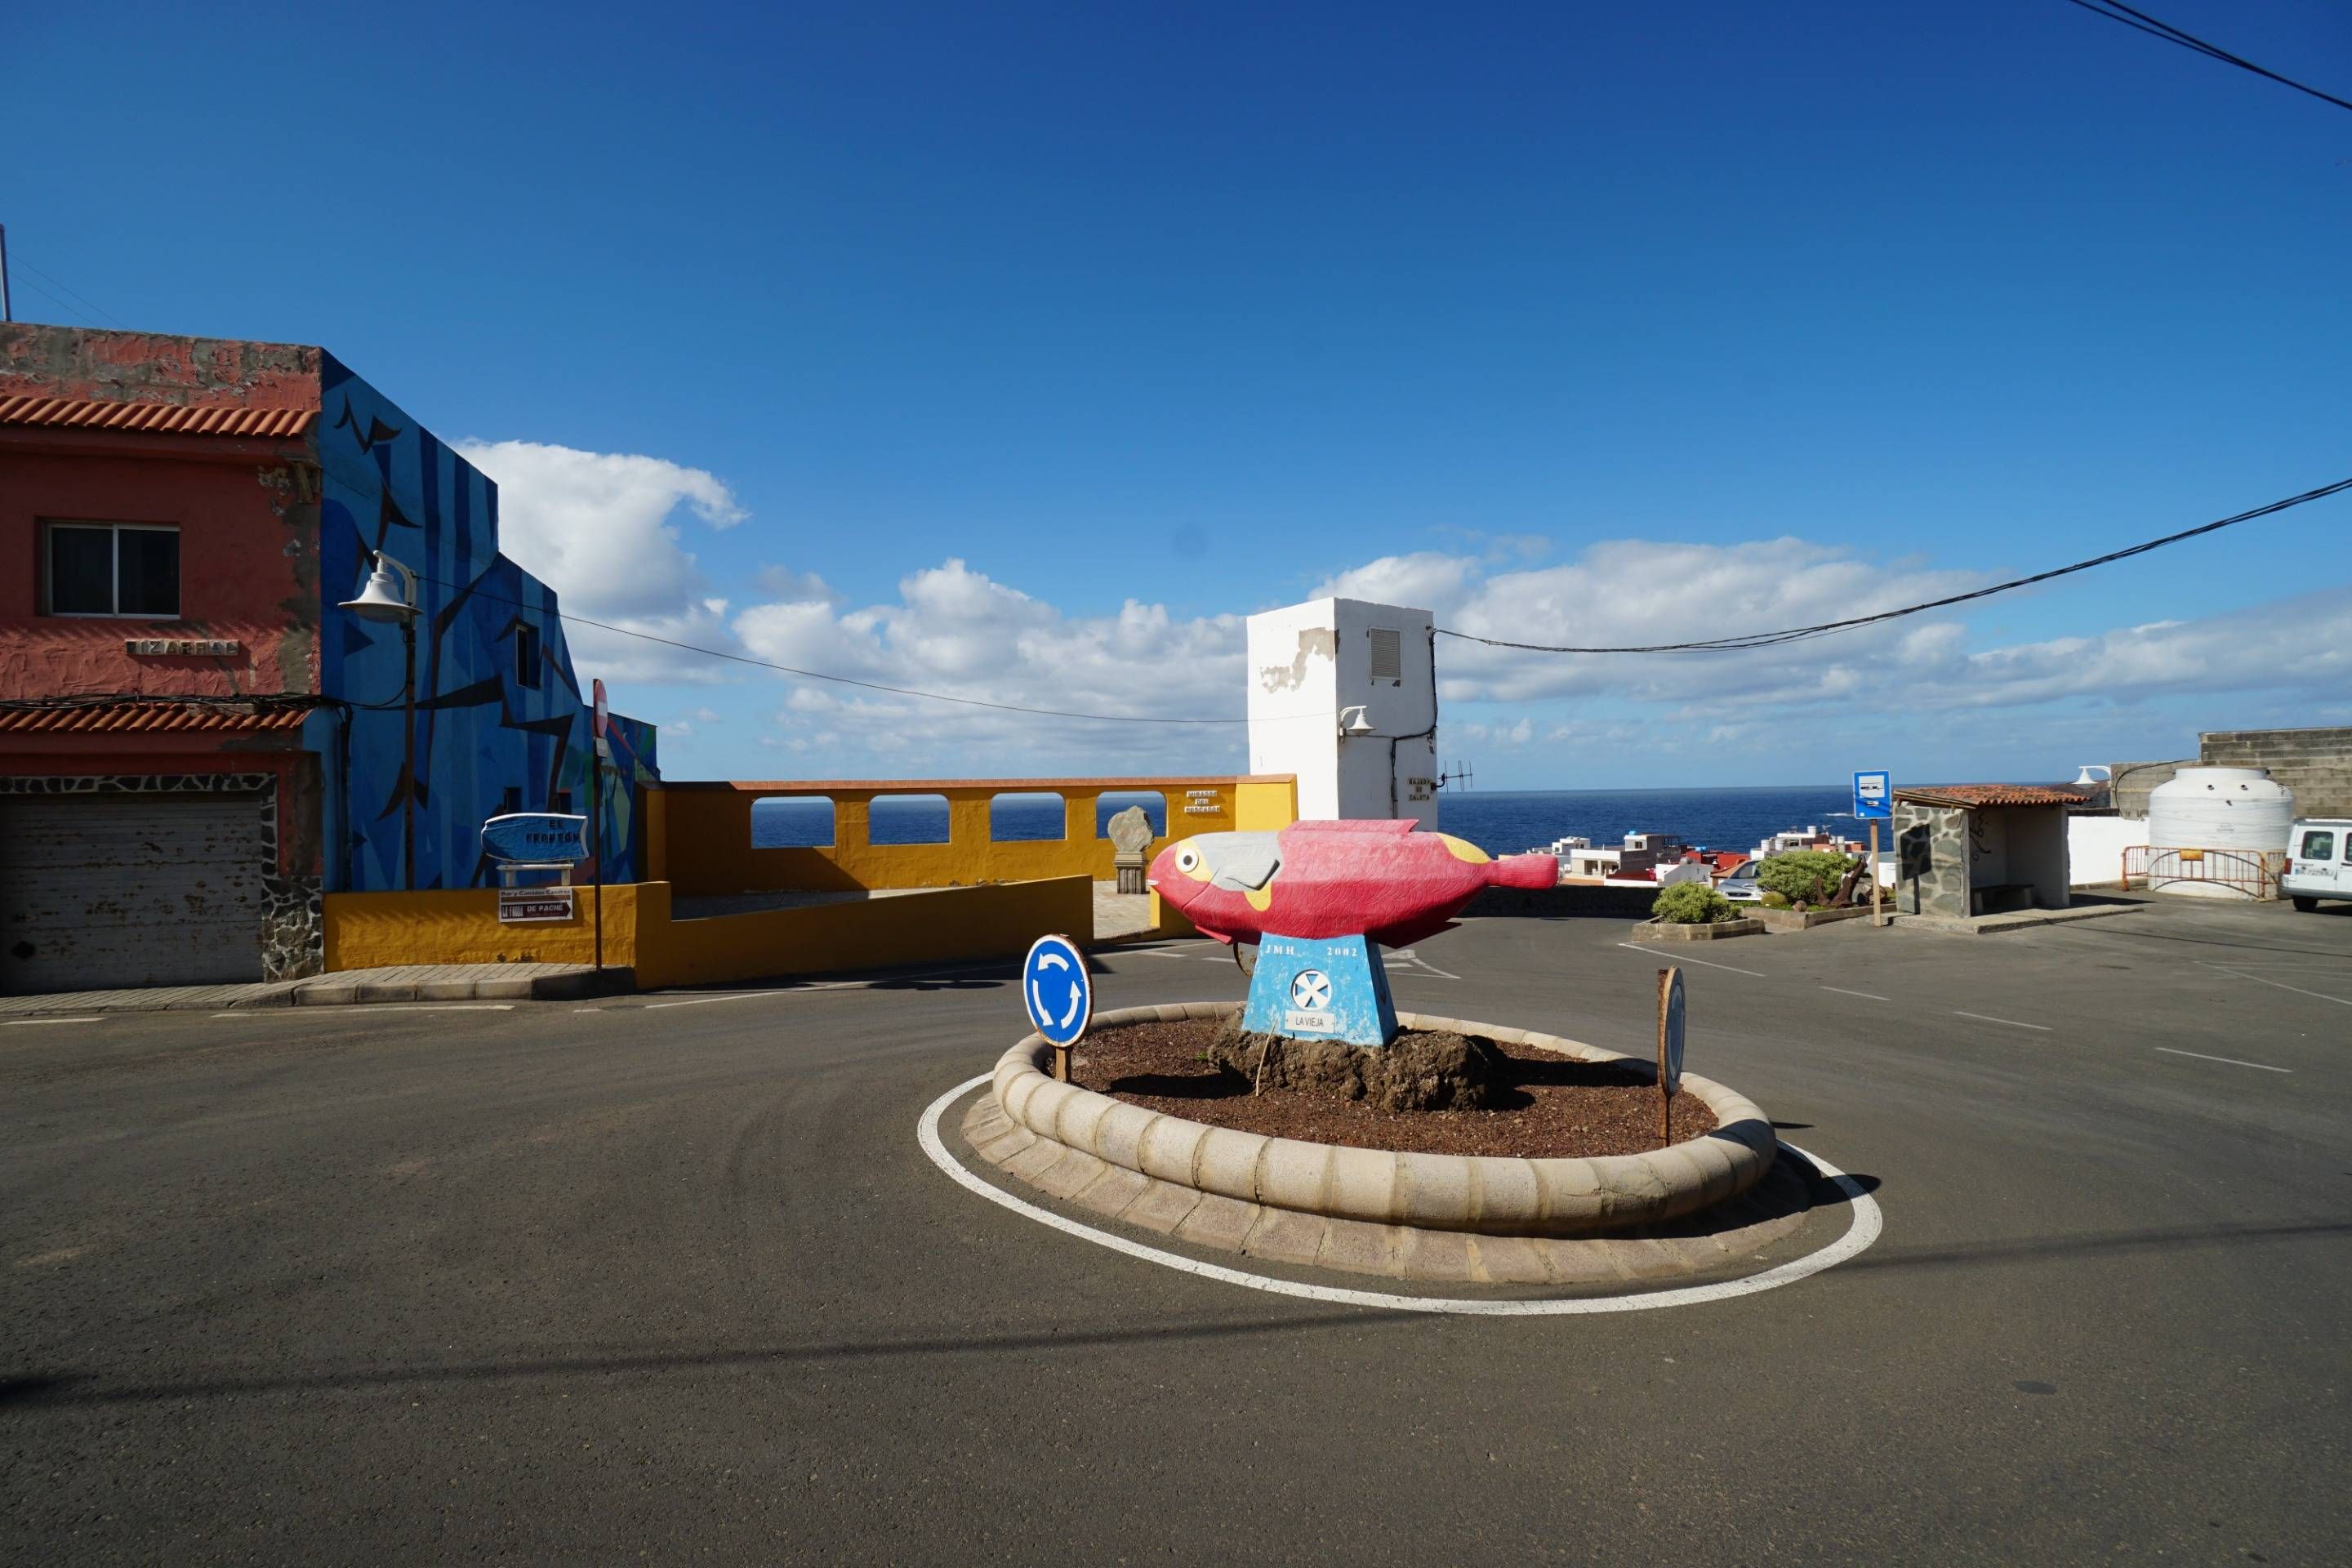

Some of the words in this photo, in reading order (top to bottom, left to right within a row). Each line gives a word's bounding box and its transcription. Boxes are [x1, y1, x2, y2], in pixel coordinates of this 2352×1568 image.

[549, 819, 563, 829] EL
[1295, 1017, 1304, 1025] LA
[1305, 1018, 1324, 1027] VIEJA
